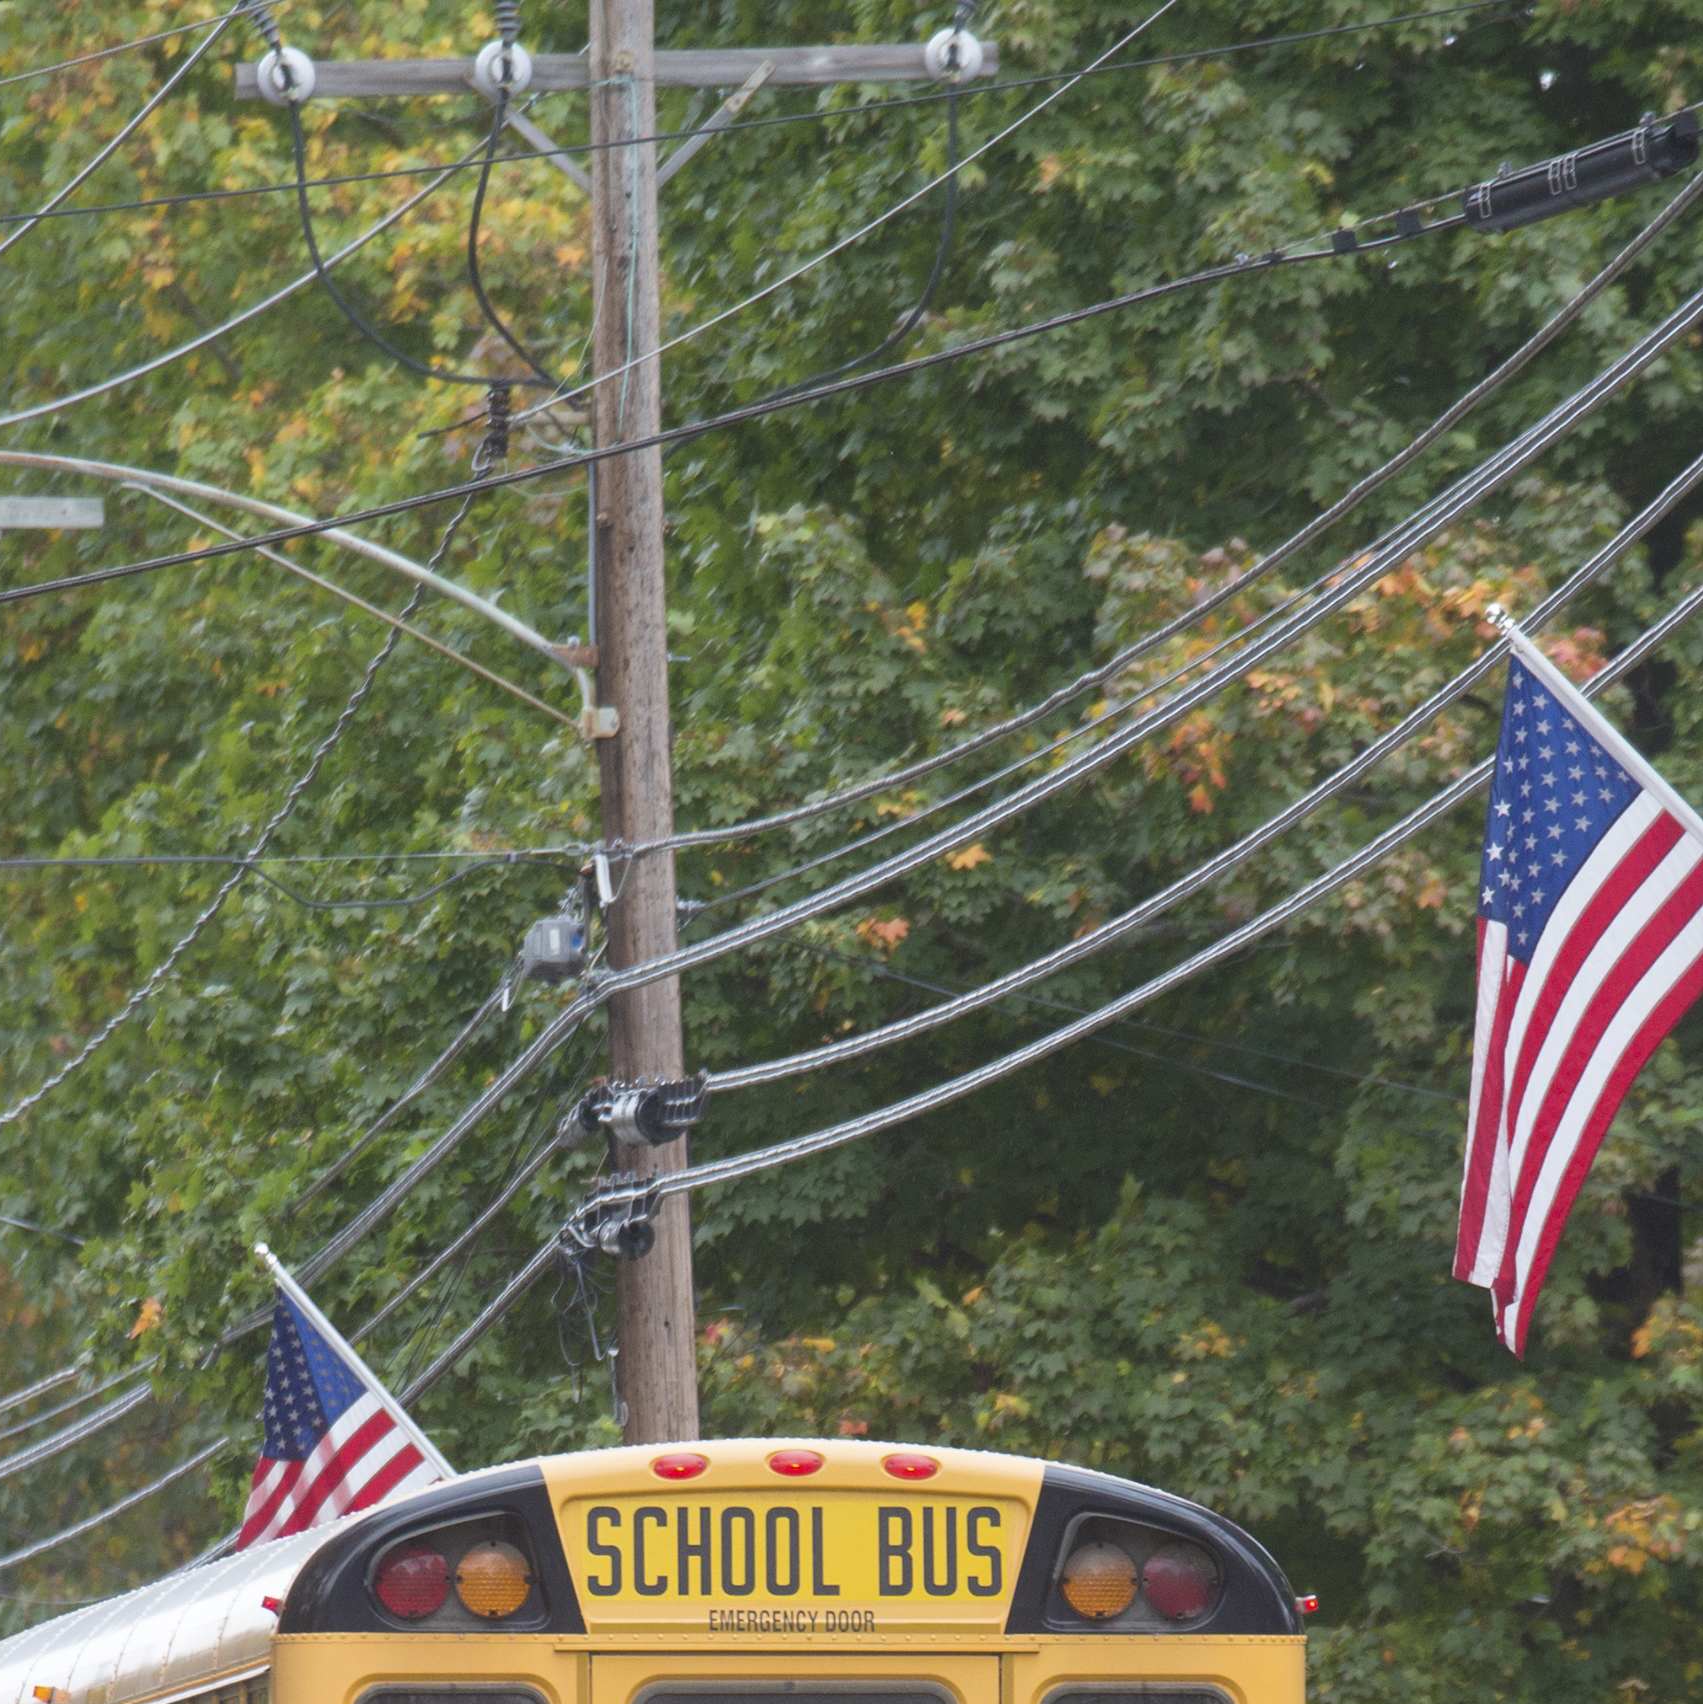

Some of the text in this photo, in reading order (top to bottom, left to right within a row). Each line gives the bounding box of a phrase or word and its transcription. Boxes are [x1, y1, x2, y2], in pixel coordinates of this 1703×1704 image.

[587, 1506, 1002, 1597] SCHOOL BUS
[709, 1610, 875, 1633] EMERGENCY DOOR
